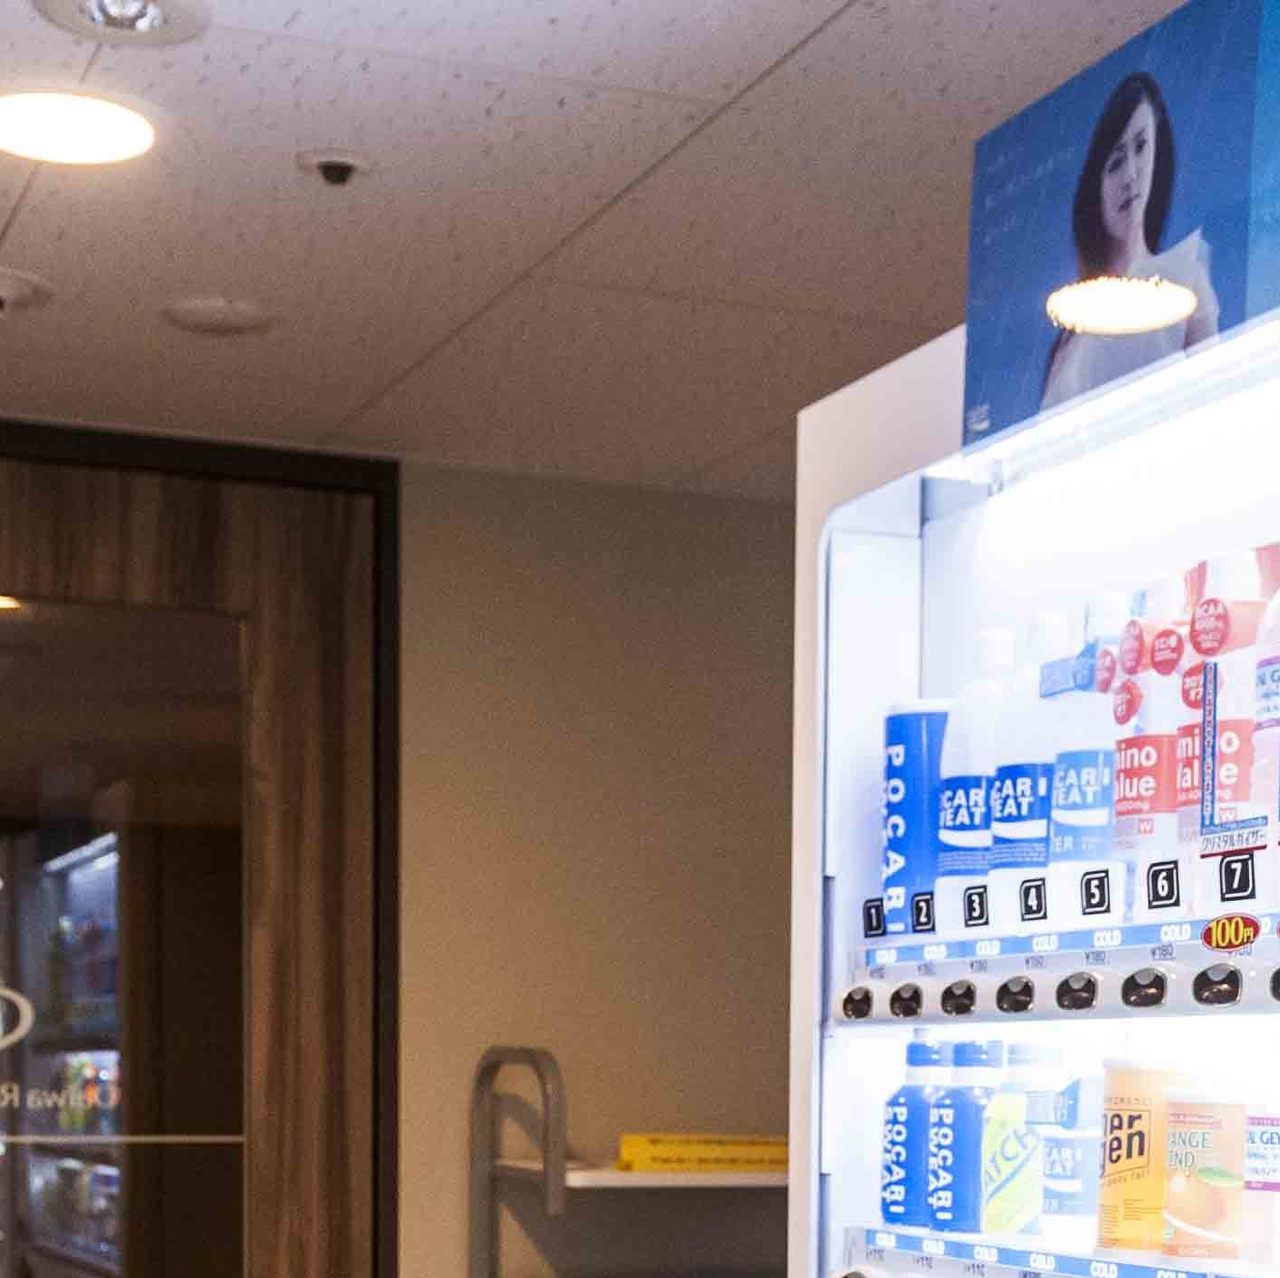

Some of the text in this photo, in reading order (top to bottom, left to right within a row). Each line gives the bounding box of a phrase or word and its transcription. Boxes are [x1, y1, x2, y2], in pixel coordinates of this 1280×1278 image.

[884, 744, 906, 932] POCARI
[1157, 872, 1168, 897] 6
[1231, 863, 1243, 889] 7
[1027, 887, 1038, 910] 4
[1091, 880, 1101, 905] 5
[870, 908, 878, 928] 1
[919, 901, 929, 922] 2
[971, 895, 981, 917] 3
[1159, 922, 1192, 942] COLD
[1208, 915, 1255, 947] 100円
[888, 1104, 908, 1215] POCARI
[1101, 1129, 1145, 1165] en
[936, 1106, 955, 1221] POCARI
[1090, 1261, 1119, 1278] COLD
